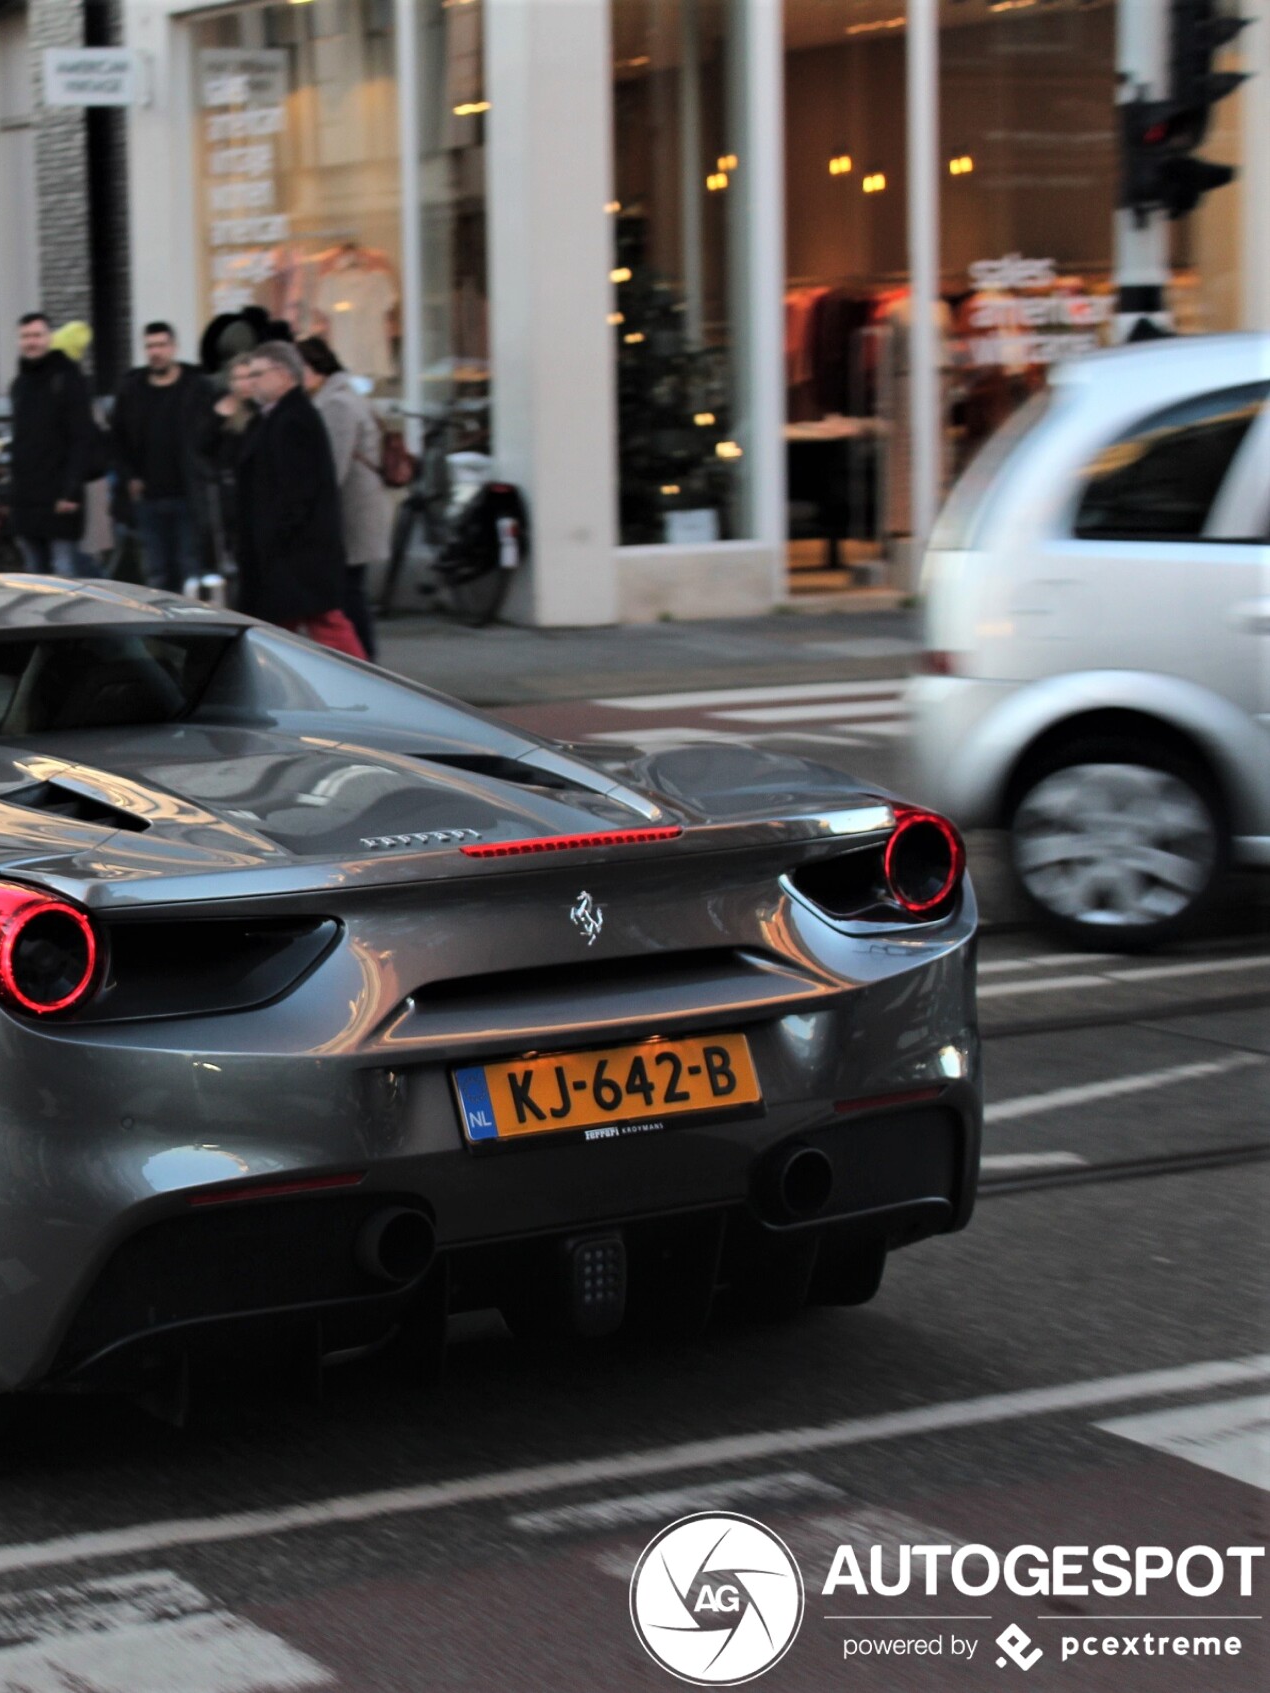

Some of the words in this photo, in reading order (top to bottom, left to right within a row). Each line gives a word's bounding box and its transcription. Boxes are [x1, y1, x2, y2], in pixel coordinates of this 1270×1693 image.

[507, 1045, 737, 1125] KJ-642-B
[469, 1111, 492, 1128] NL
[584, 1126, 620, 1141] Ferrari
[621, 1122, 664, 1134] KROYMANS
